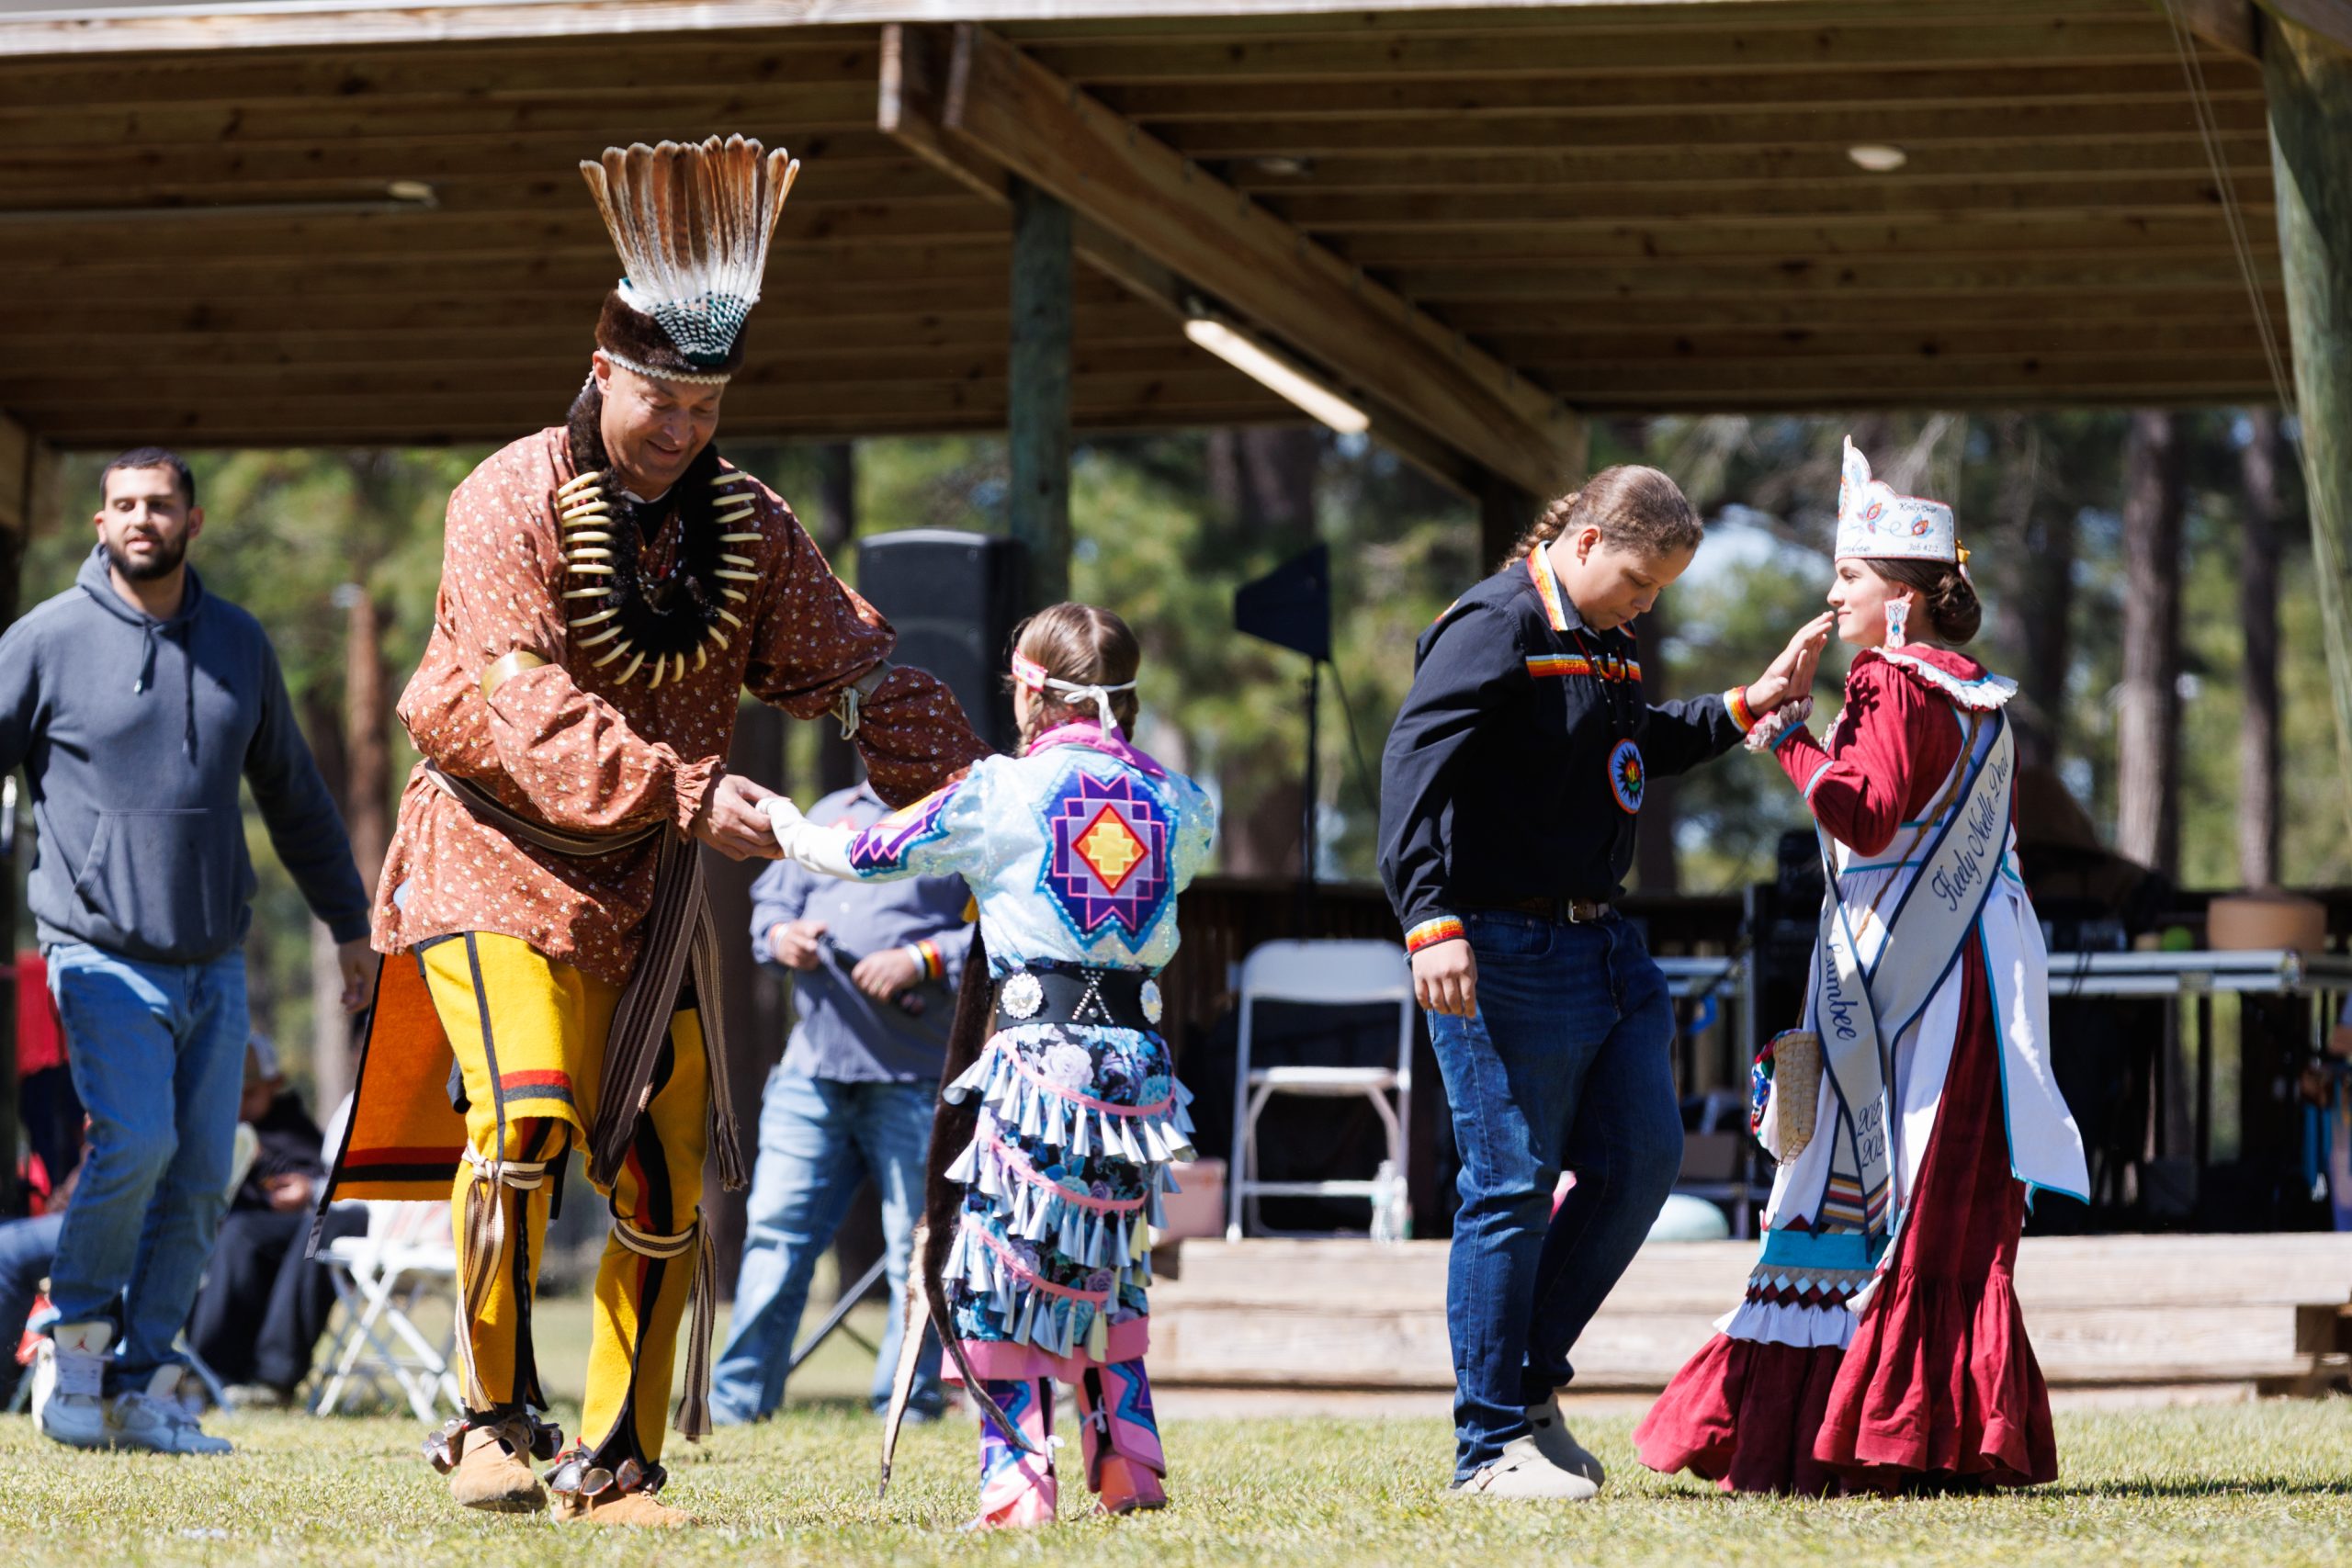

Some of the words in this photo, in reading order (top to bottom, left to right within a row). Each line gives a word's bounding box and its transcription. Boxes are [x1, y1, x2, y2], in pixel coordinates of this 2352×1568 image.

[1932, 850, 1983, 912] Keely
[1968, 791, 1996, 857] Noelle
[1989, 739, 2009, 803] Deal
[1826, 930, 1859, 1041] Lumbee
